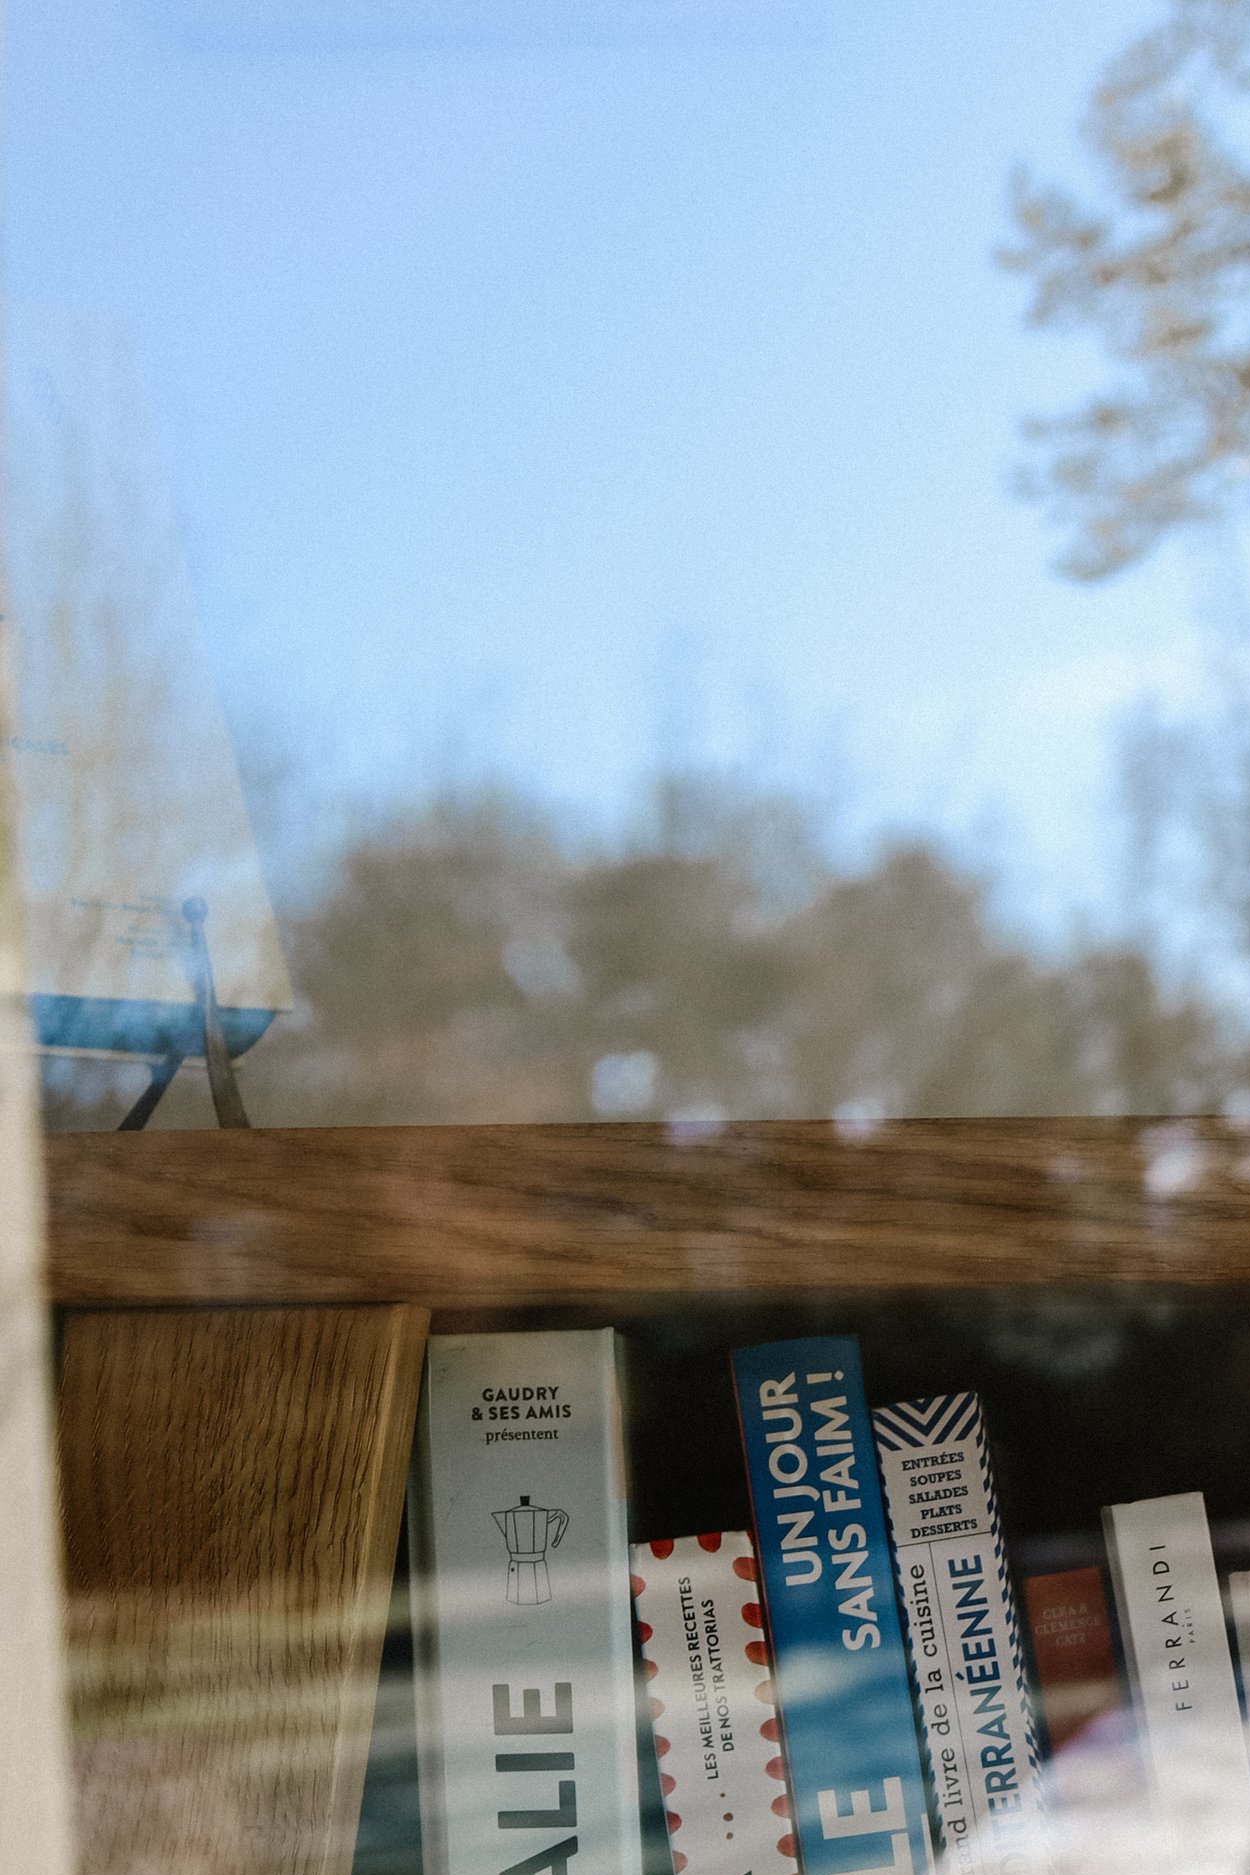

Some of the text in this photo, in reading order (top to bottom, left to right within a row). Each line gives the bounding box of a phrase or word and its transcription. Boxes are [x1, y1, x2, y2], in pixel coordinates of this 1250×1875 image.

[471, 1403, 572, 1420] & SES AMIS
[482, 1386, 560, 1403] GAUDRY
[485, 1427, 559, 1443] présentent
[810, 1395, 862, 1513] FAIM
[902, 1450, 965, 1471] ENTRÉES
[759, 1371, 823, 1587] UN JOUR
[908, 1485, 969, 1504] SALADES
[909, 1470, 962, 1487] SOUPES
[910, 1518, 977, 1539] DESSERTS
[920, 1504, 963, 1520] PLATS
[827, 1523, 881, 1652] SANS
[909, 1562, 939, 1659] cuisine
[1148, 1545, 1194, 1711] FERRANDI
[1184, 1608, 1196, 1644] PARIS
[678, 1576, 719, 1780] LES MEILLEURES RECETTES
[701, 1599, 735, 1752] DE NOS TRATTORIAS
[925, 1667, 944, 1695] la
[931, 1702, 951, 1737] de
[939, 1748, 962, 1809] livre
